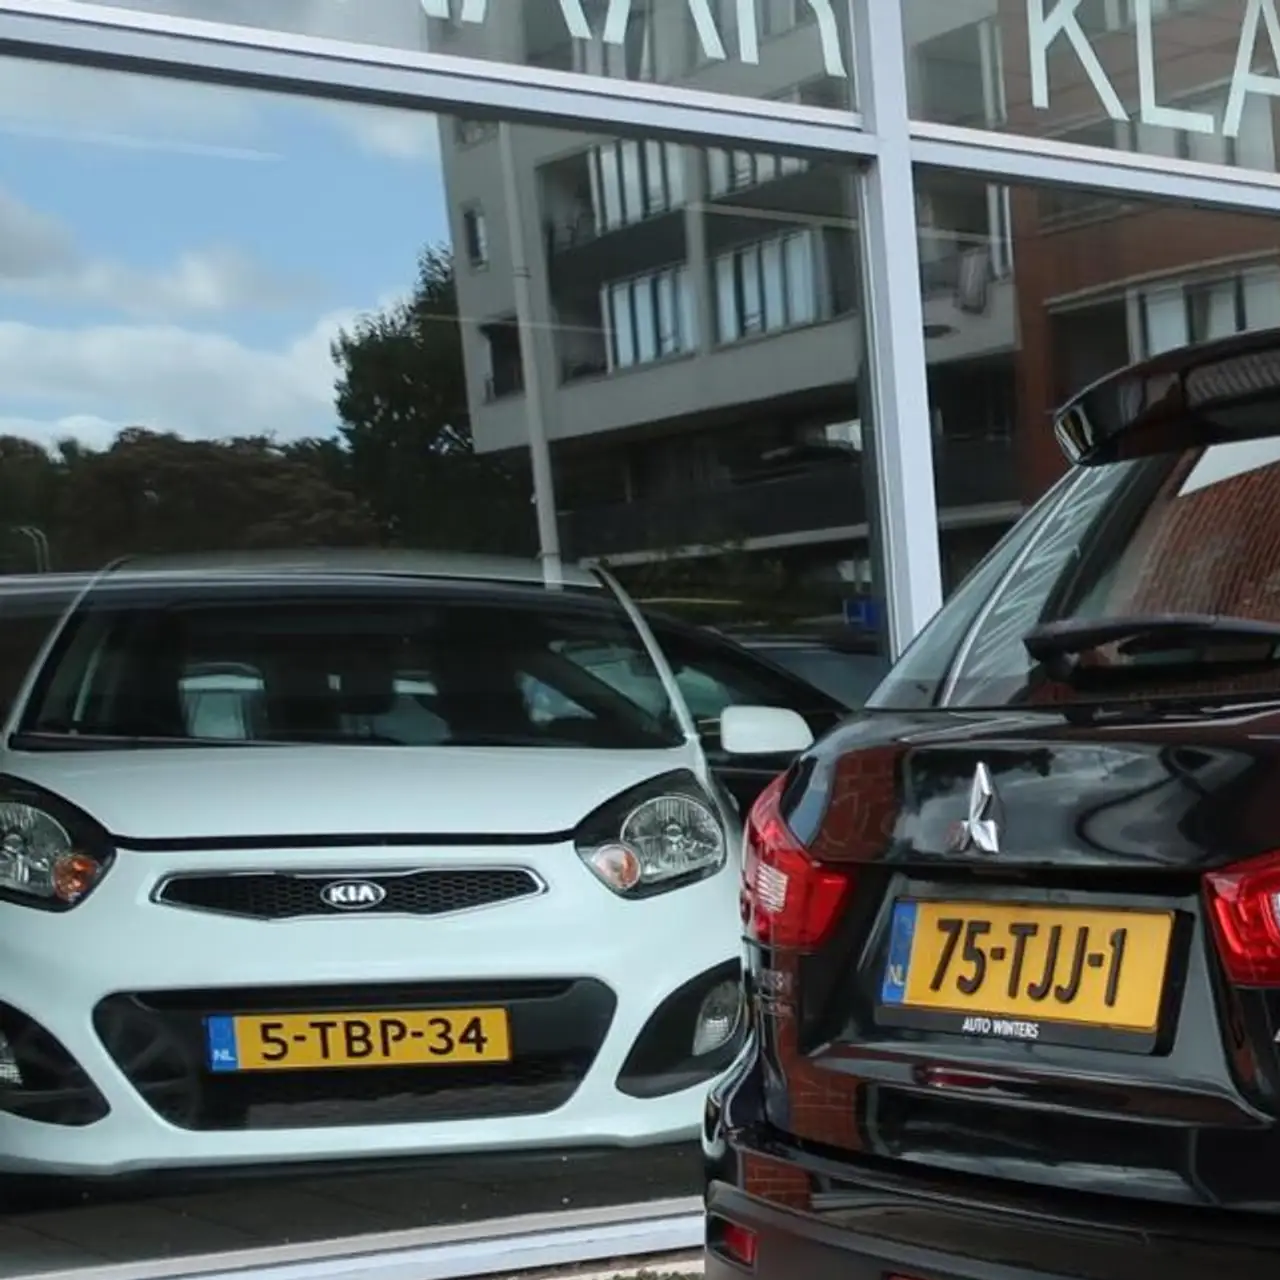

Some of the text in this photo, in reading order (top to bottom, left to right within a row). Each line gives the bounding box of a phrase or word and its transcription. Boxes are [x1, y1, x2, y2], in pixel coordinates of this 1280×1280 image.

[329, 884, 377, 903] KIA
[929, 917, 1128, 1008] 75-TJJ-1
[887, 963, 905, 987] NL
[259, 1015, 488, 1062] 5-TBP-34
[961, 1016, 1040, 1040] AUTO WINTERS
[212, 1048, 237, 1062] NL
